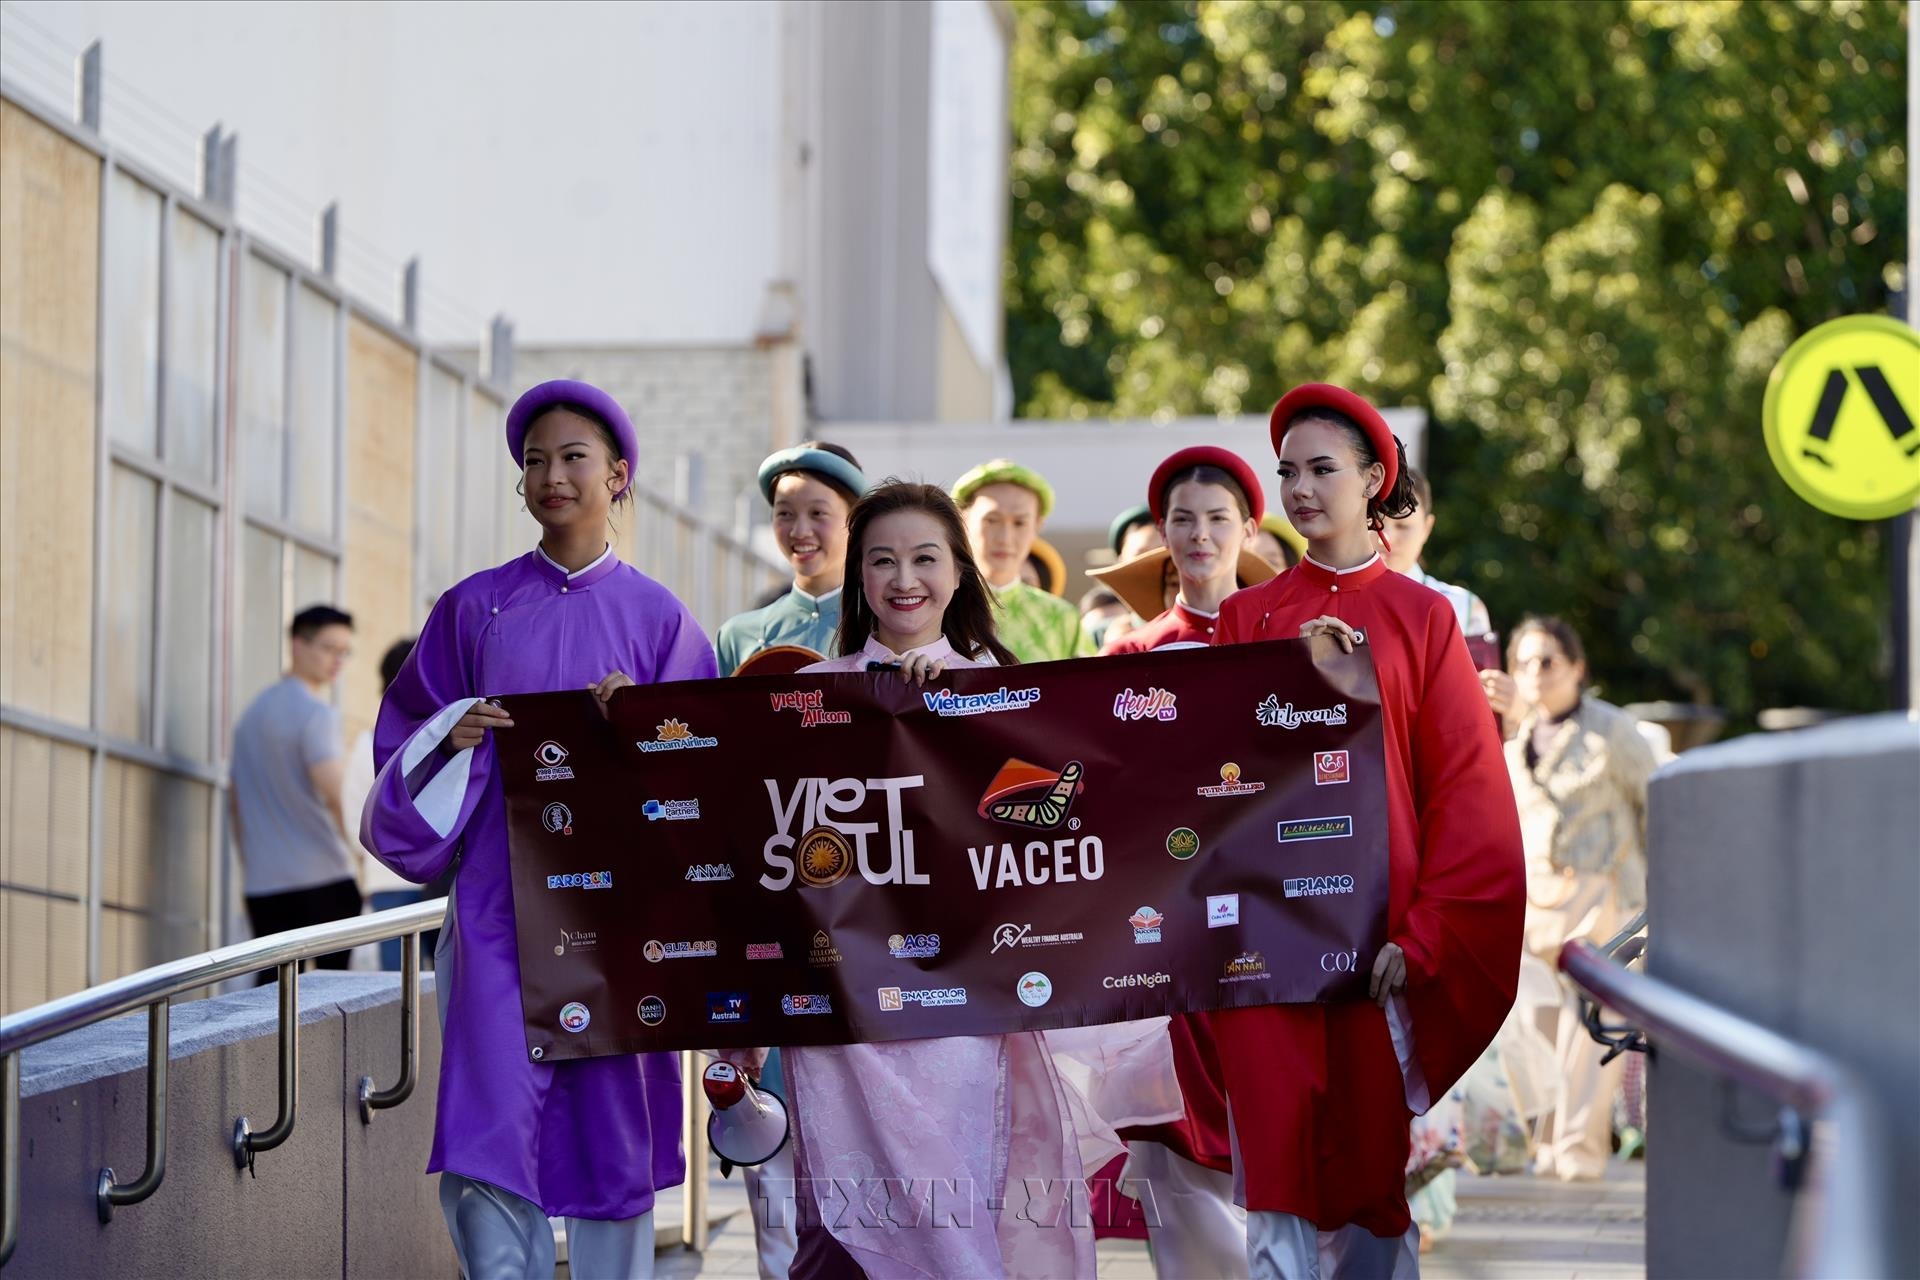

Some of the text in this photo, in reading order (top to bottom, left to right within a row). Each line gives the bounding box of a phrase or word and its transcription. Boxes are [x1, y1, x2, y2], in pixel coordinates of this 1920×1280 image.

[1160, 709, 1174, 717] TV
[665, 799, 698, 808] Advanced
[666, 807, 699, 816] Partners
[967, 835, 1105, 891] VACEO
[1297, 875, 1354, 891] PIANO
[903, 934, 940, 949] AGS
[1021, 935, 1041, 944] WEALTHY
[1041, 934, 1060, 943] FINANCE
[1060, 932, 1083, 941] AUSTRALIA
[810, 948, 838, 957] YELLOW
[808, 955, 843, 964] DIAMOND
[1102, 972, 1171, 989] Café Ngân
[729, 1000, 741, 1008] TV
[712, 1011, 740, 1020] Australia
